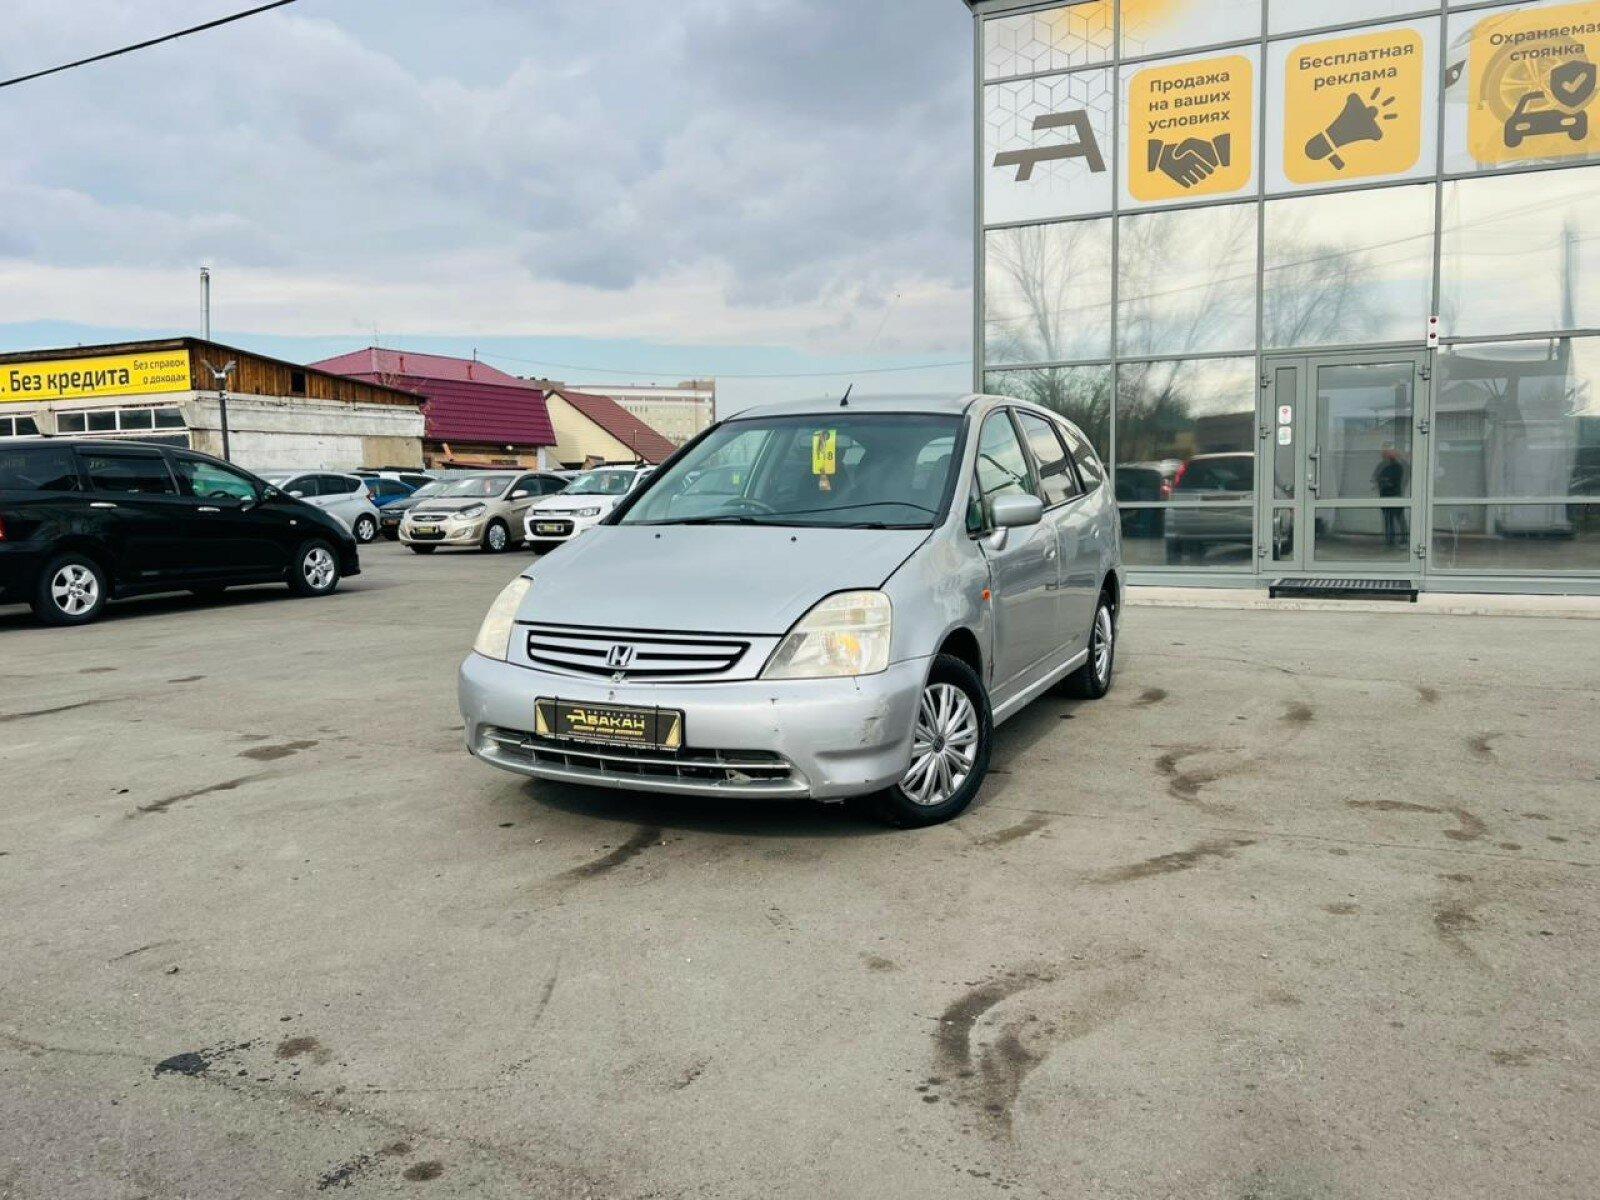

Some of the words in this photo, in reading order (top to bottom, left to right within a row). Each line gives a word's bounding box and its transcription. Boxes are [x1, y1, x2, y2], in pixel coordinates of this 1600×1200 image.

[1299, 44, 1414, 70] Бесплатная
[1510, 43, 1585, 61] стоянка
[1150, 71, 1230, 92] Продажа
[1314, 66, 1397, 90] реклама
[1149, 101, 1168, 111] на
[1174, 90, 1230, 108] ваших
[1148, 110, 1230, 133] условиях
[133, 359, 149, 371] Без
[150, 359, 186, 371] справок
[9, 369, 42, 392] Без
[47, 367, 130, 395] кредита
[143, 377, 148, 385] о
[149, 374, 186, 385] доходах
